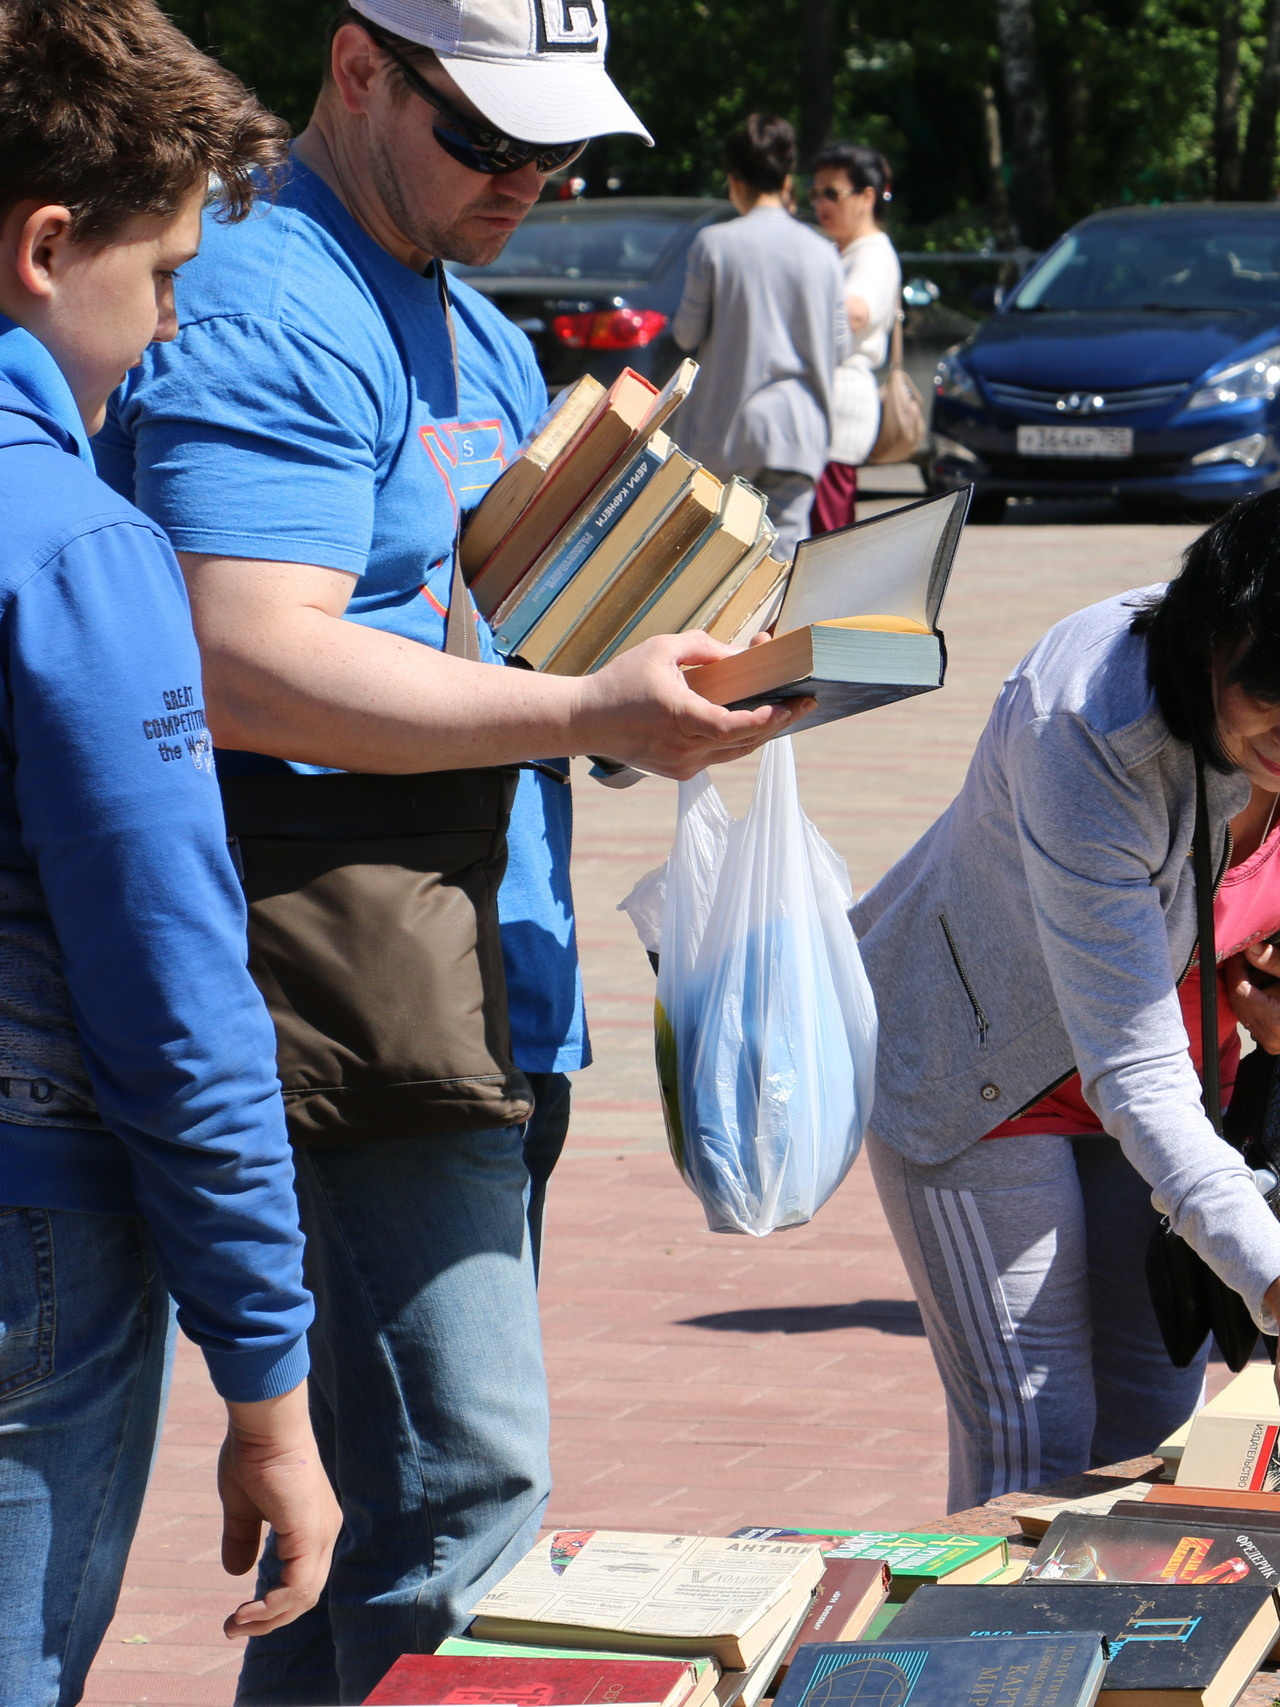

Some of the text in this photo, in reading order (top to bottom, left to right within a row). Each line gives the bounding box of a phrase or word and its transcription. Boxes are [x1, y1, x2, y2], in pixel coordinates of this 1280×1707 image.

[595, 487, 630, 528] КАРНЕГИ
[162, 686, 194, 711] GREAT
[158, 743, 182, 762] the
[1238, 1423, 1265, 1489] ИЗДАТЕЛЬСТВО
[1234, 1533, 1279, 1581] ФРЕДЕРИК
